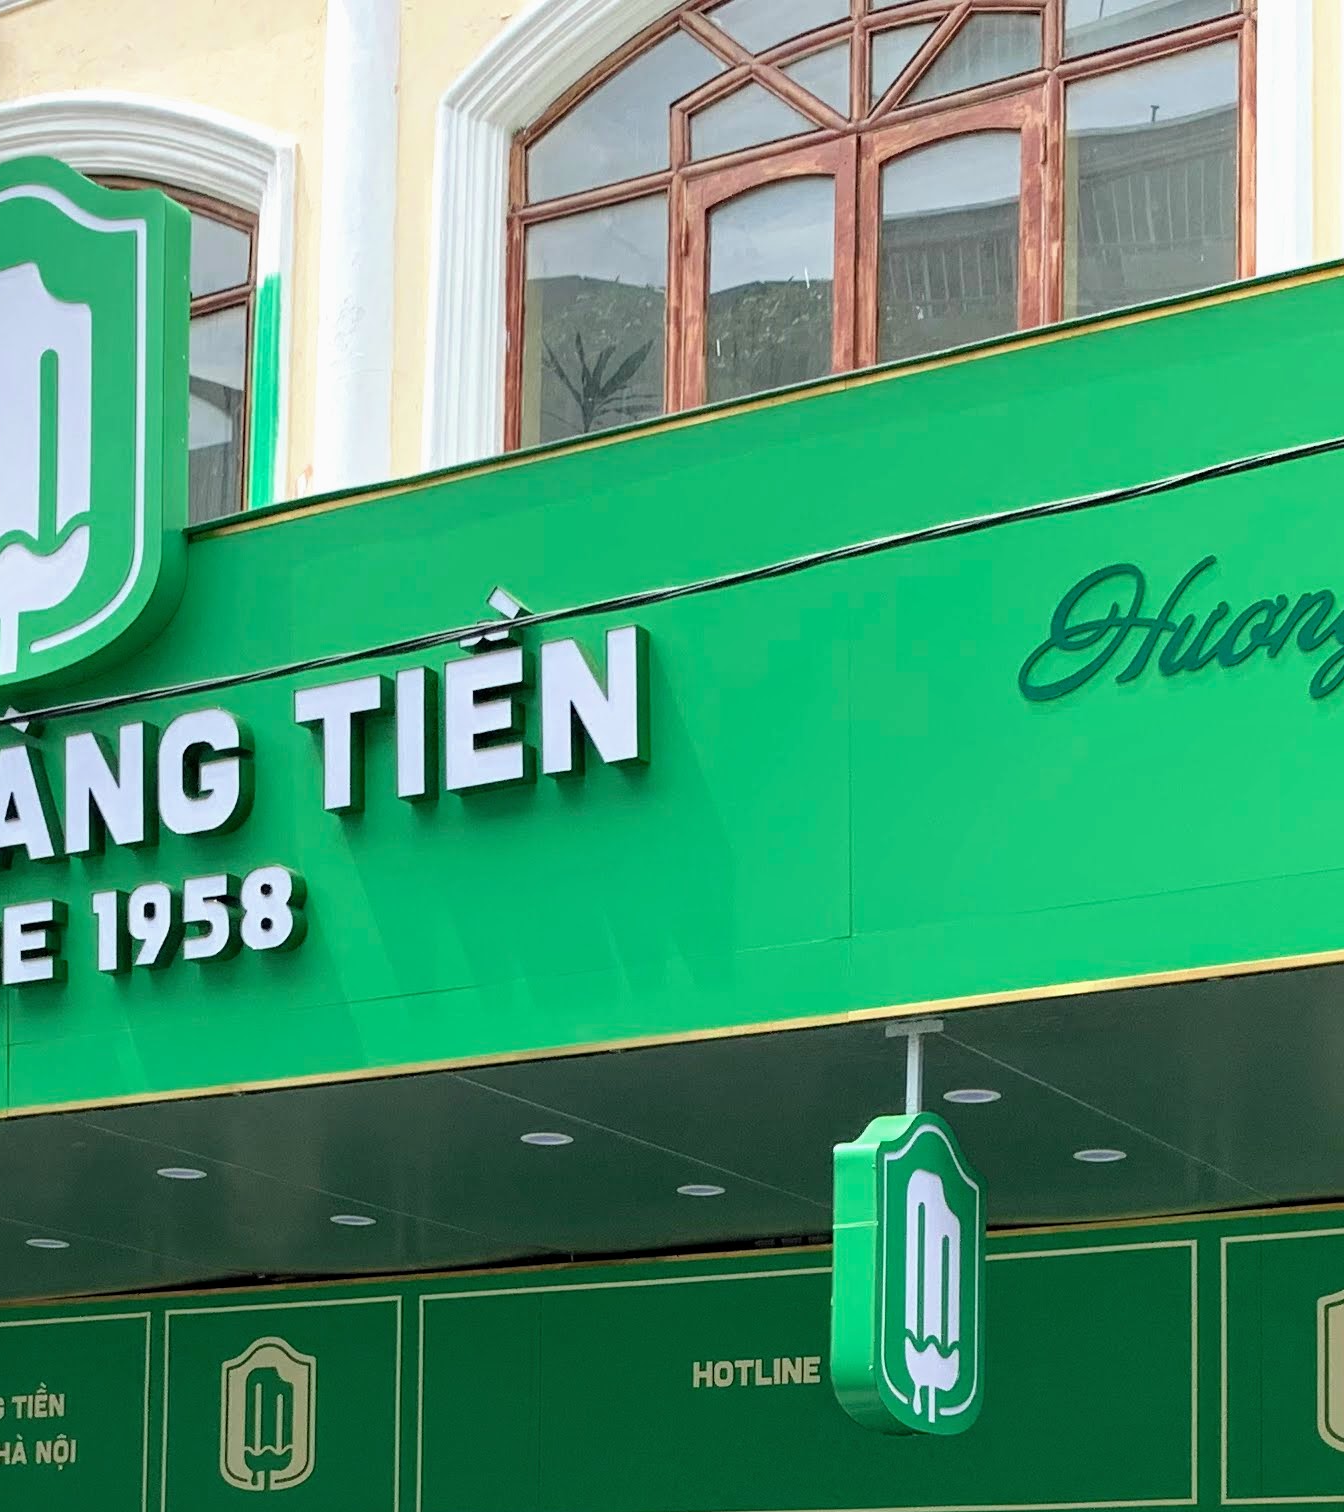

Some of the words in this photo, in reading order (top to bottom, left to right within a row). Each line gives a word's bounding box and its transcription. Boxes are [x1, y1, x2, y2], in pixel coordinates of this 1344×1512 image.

[293, 586, 649, 813] TIỀN
[93, 863, 306, 973] 1958
[692, 1356, 820, 1388] HOTLINE
[11, 1382, 65, 1419] TIỀN
[35, 1433, 77, 1471] NỘI
